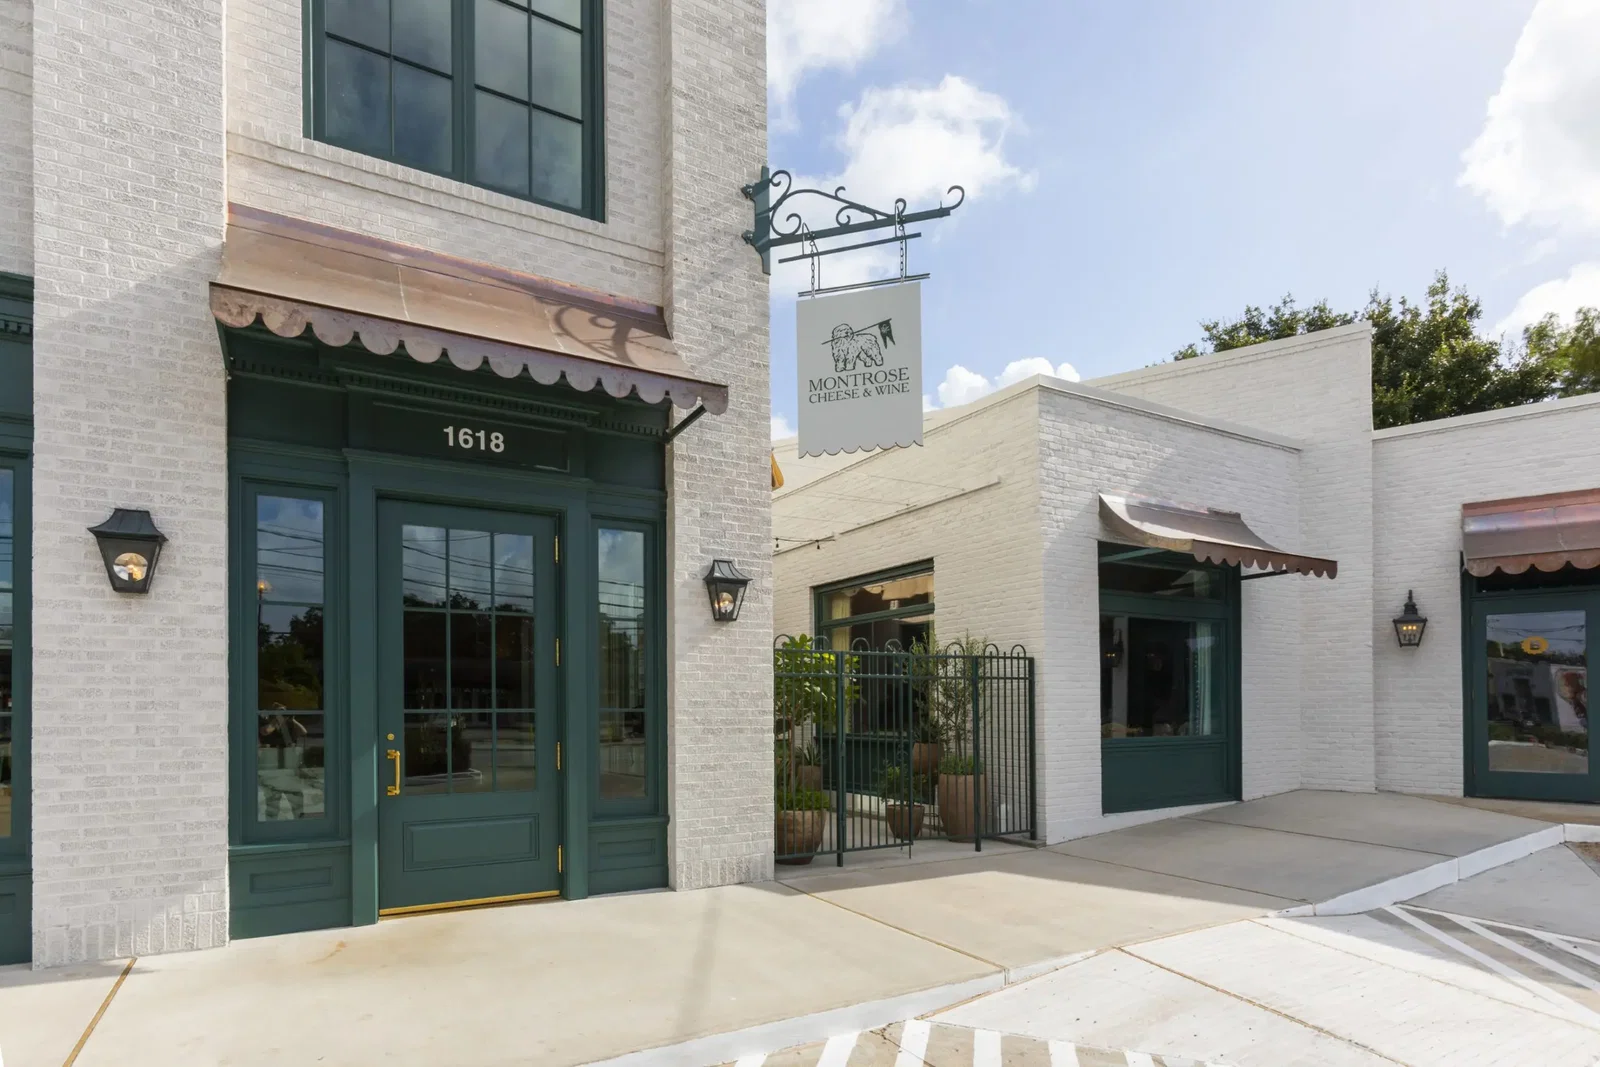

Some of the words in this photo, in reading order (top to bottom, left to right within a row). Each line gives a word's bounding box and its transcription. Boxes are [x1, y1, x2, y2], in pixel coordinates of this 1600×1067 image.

[809, 367, 910, 392] MONTROSE
[808, 388, 860, 404] CHEESE
[862, 387, 872, 398] &
[874, 382, 910, 396] WINE
[443, 425, 505, 453] 1618
